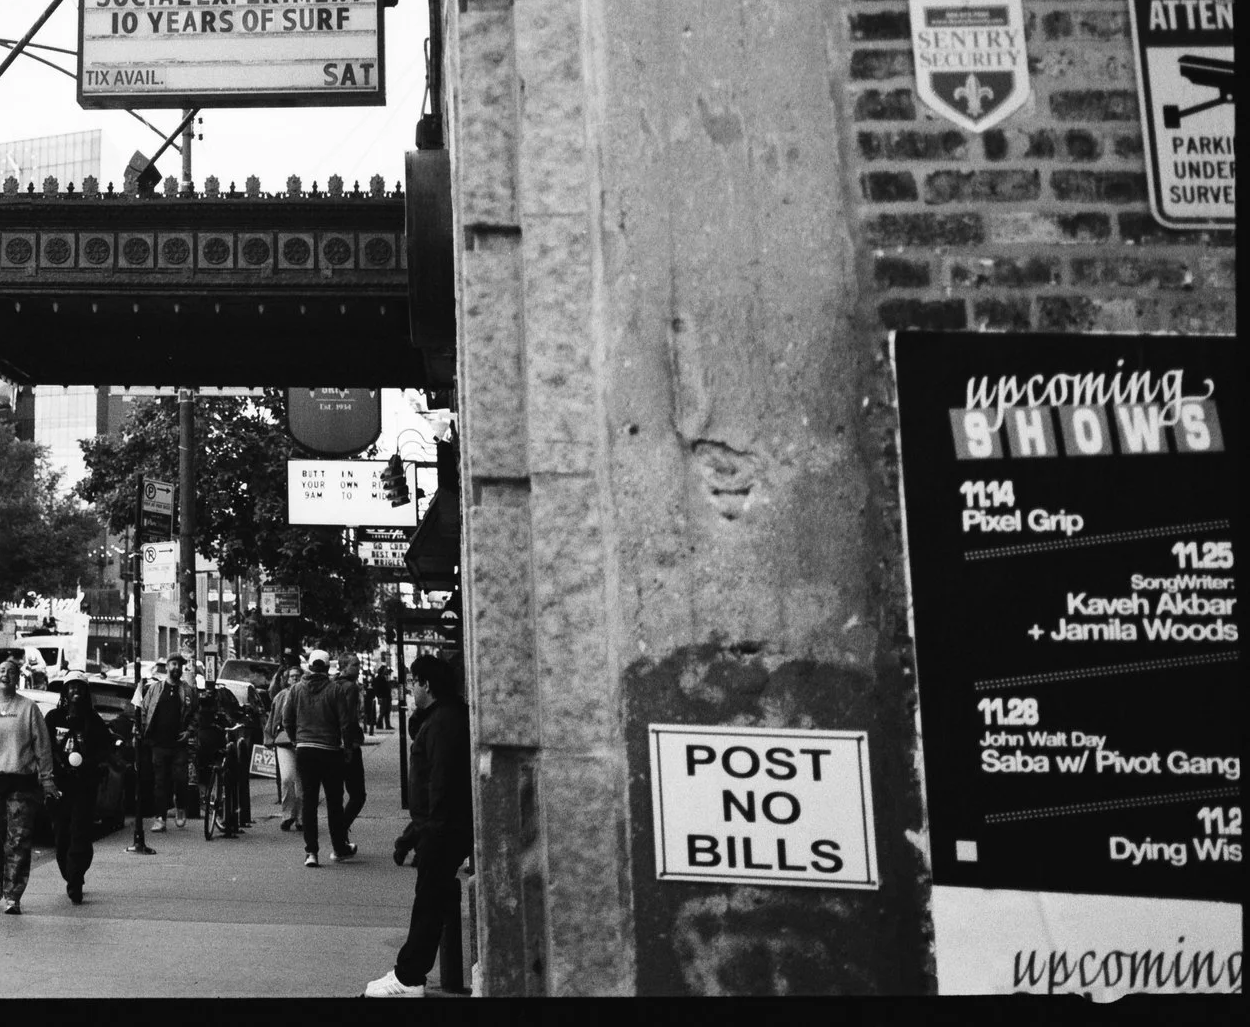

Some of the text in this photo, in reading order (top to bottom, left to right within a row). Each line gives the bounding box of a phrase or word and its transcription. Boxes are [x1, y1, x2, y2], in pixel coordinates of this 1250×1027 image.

[111, 7, 350, 34] 10 YEARS OF SURF
[918, 29, 1018, 49] SENTRY
[919, 50, 1021, 69] SECURITY
[85, 62, 375, 87] TIX AVAIL. SAT
[965, 358, 1215, 433] upcoming
[963, 403, 1212, 458] SHOWS
[301, 481, 326, 489] YOUR
[340, 481, 359, 489] OWN
[302, 470, 326, 478] BUTT
[341, 470, 354, 478] IN
[341, 492, 353, 500] TO
[959, 480, 1016, 508] 11.14
[962, 509, 1085, 536] Pixel Grip
[1171, 541, 1235, 569] 11.25
[1130, 574, 1236, 593] SongWriter:
[1066, 592, 1238, 615] Kaveh Akbar
[1027, 618, 1239, 641] + Jamila Woods
[977, 697, 1040, 726] 11.28
[979, 731, 1107, 751] John Walt Day
[685, 744, 832, 781] POST
[981, 749, 1241, 780] Saba w/ Pivot Gang
[722, 789, 801, 825] NO
[687, 834, 844, 874] BILLS
[1109, 836, 1188, 866] Dying
